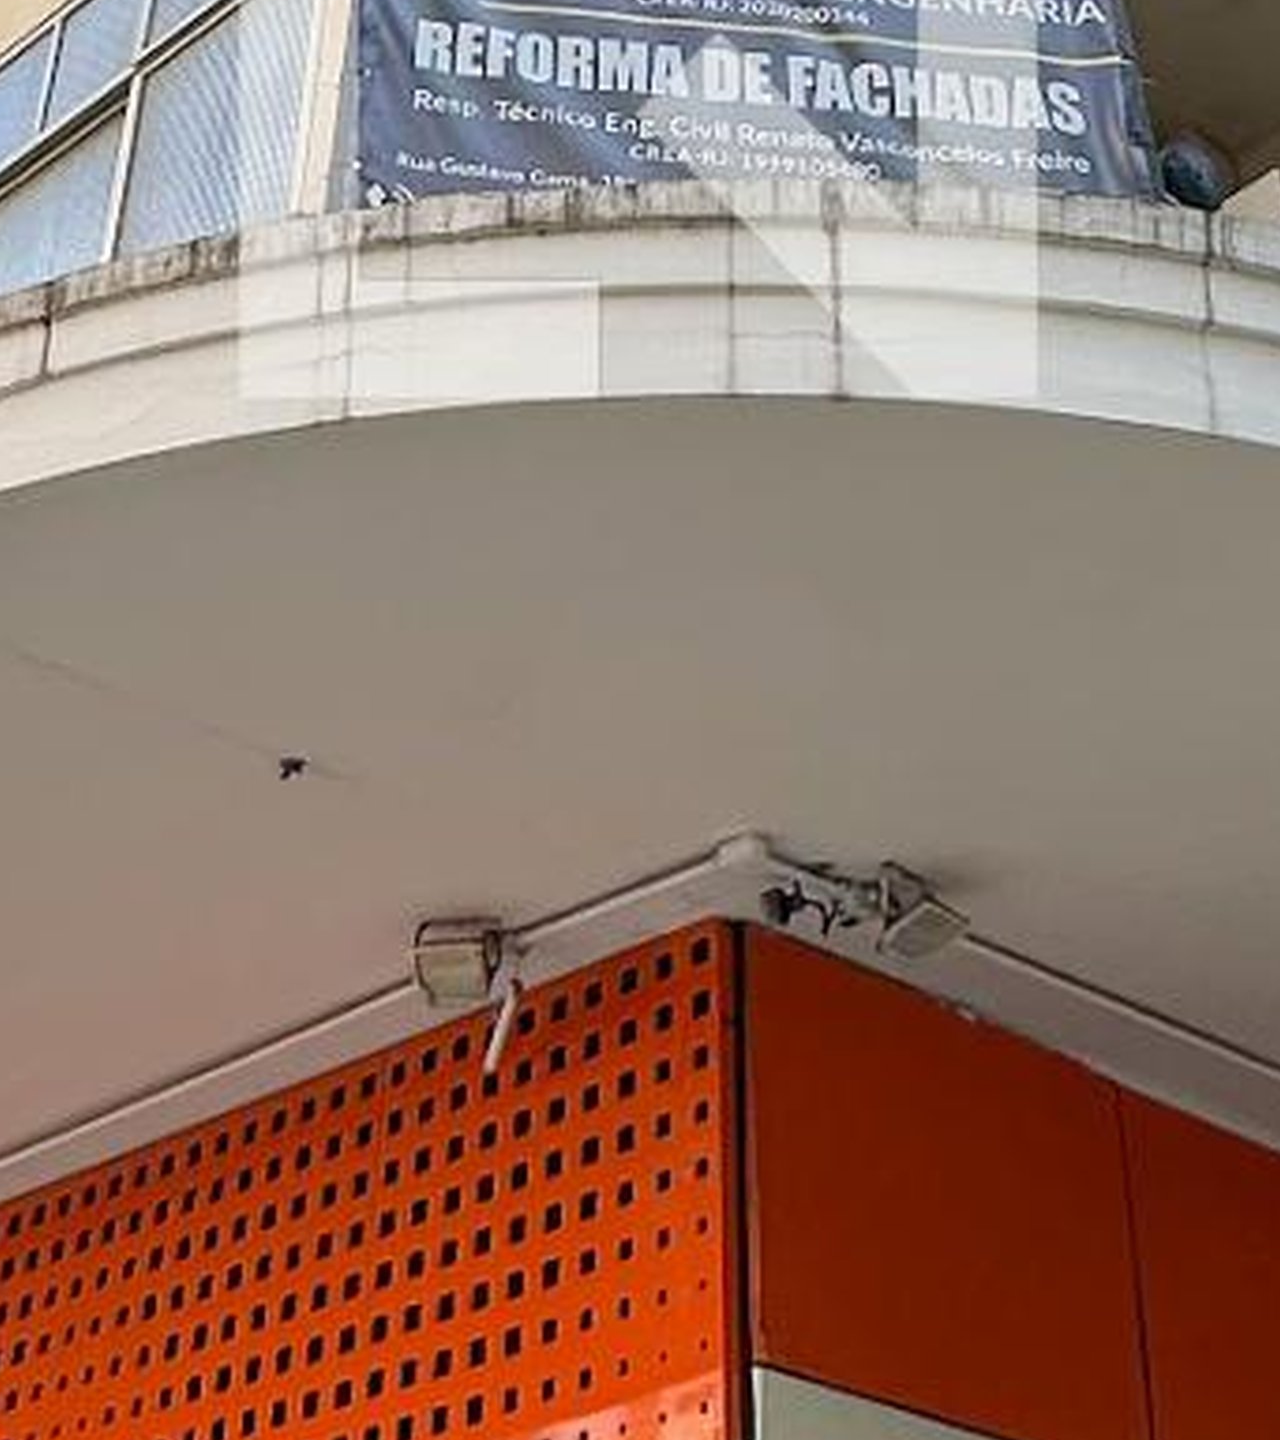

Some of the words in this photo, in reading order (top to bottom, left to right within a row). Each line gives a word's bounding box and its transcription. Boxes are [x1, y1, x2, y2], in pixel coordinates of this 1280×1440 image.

[414, 20, 690, 98] REFORMA
[703, 47, 773, 105] DE
[786, 54, 1086, 137] FACHADAS
[669, 115, 731, 141] Civil
[738, 122, 836, 151] Renato
[841, 133, 1005, 167] Vasconcelos
[1011, 145, 1092, 175] Freire
